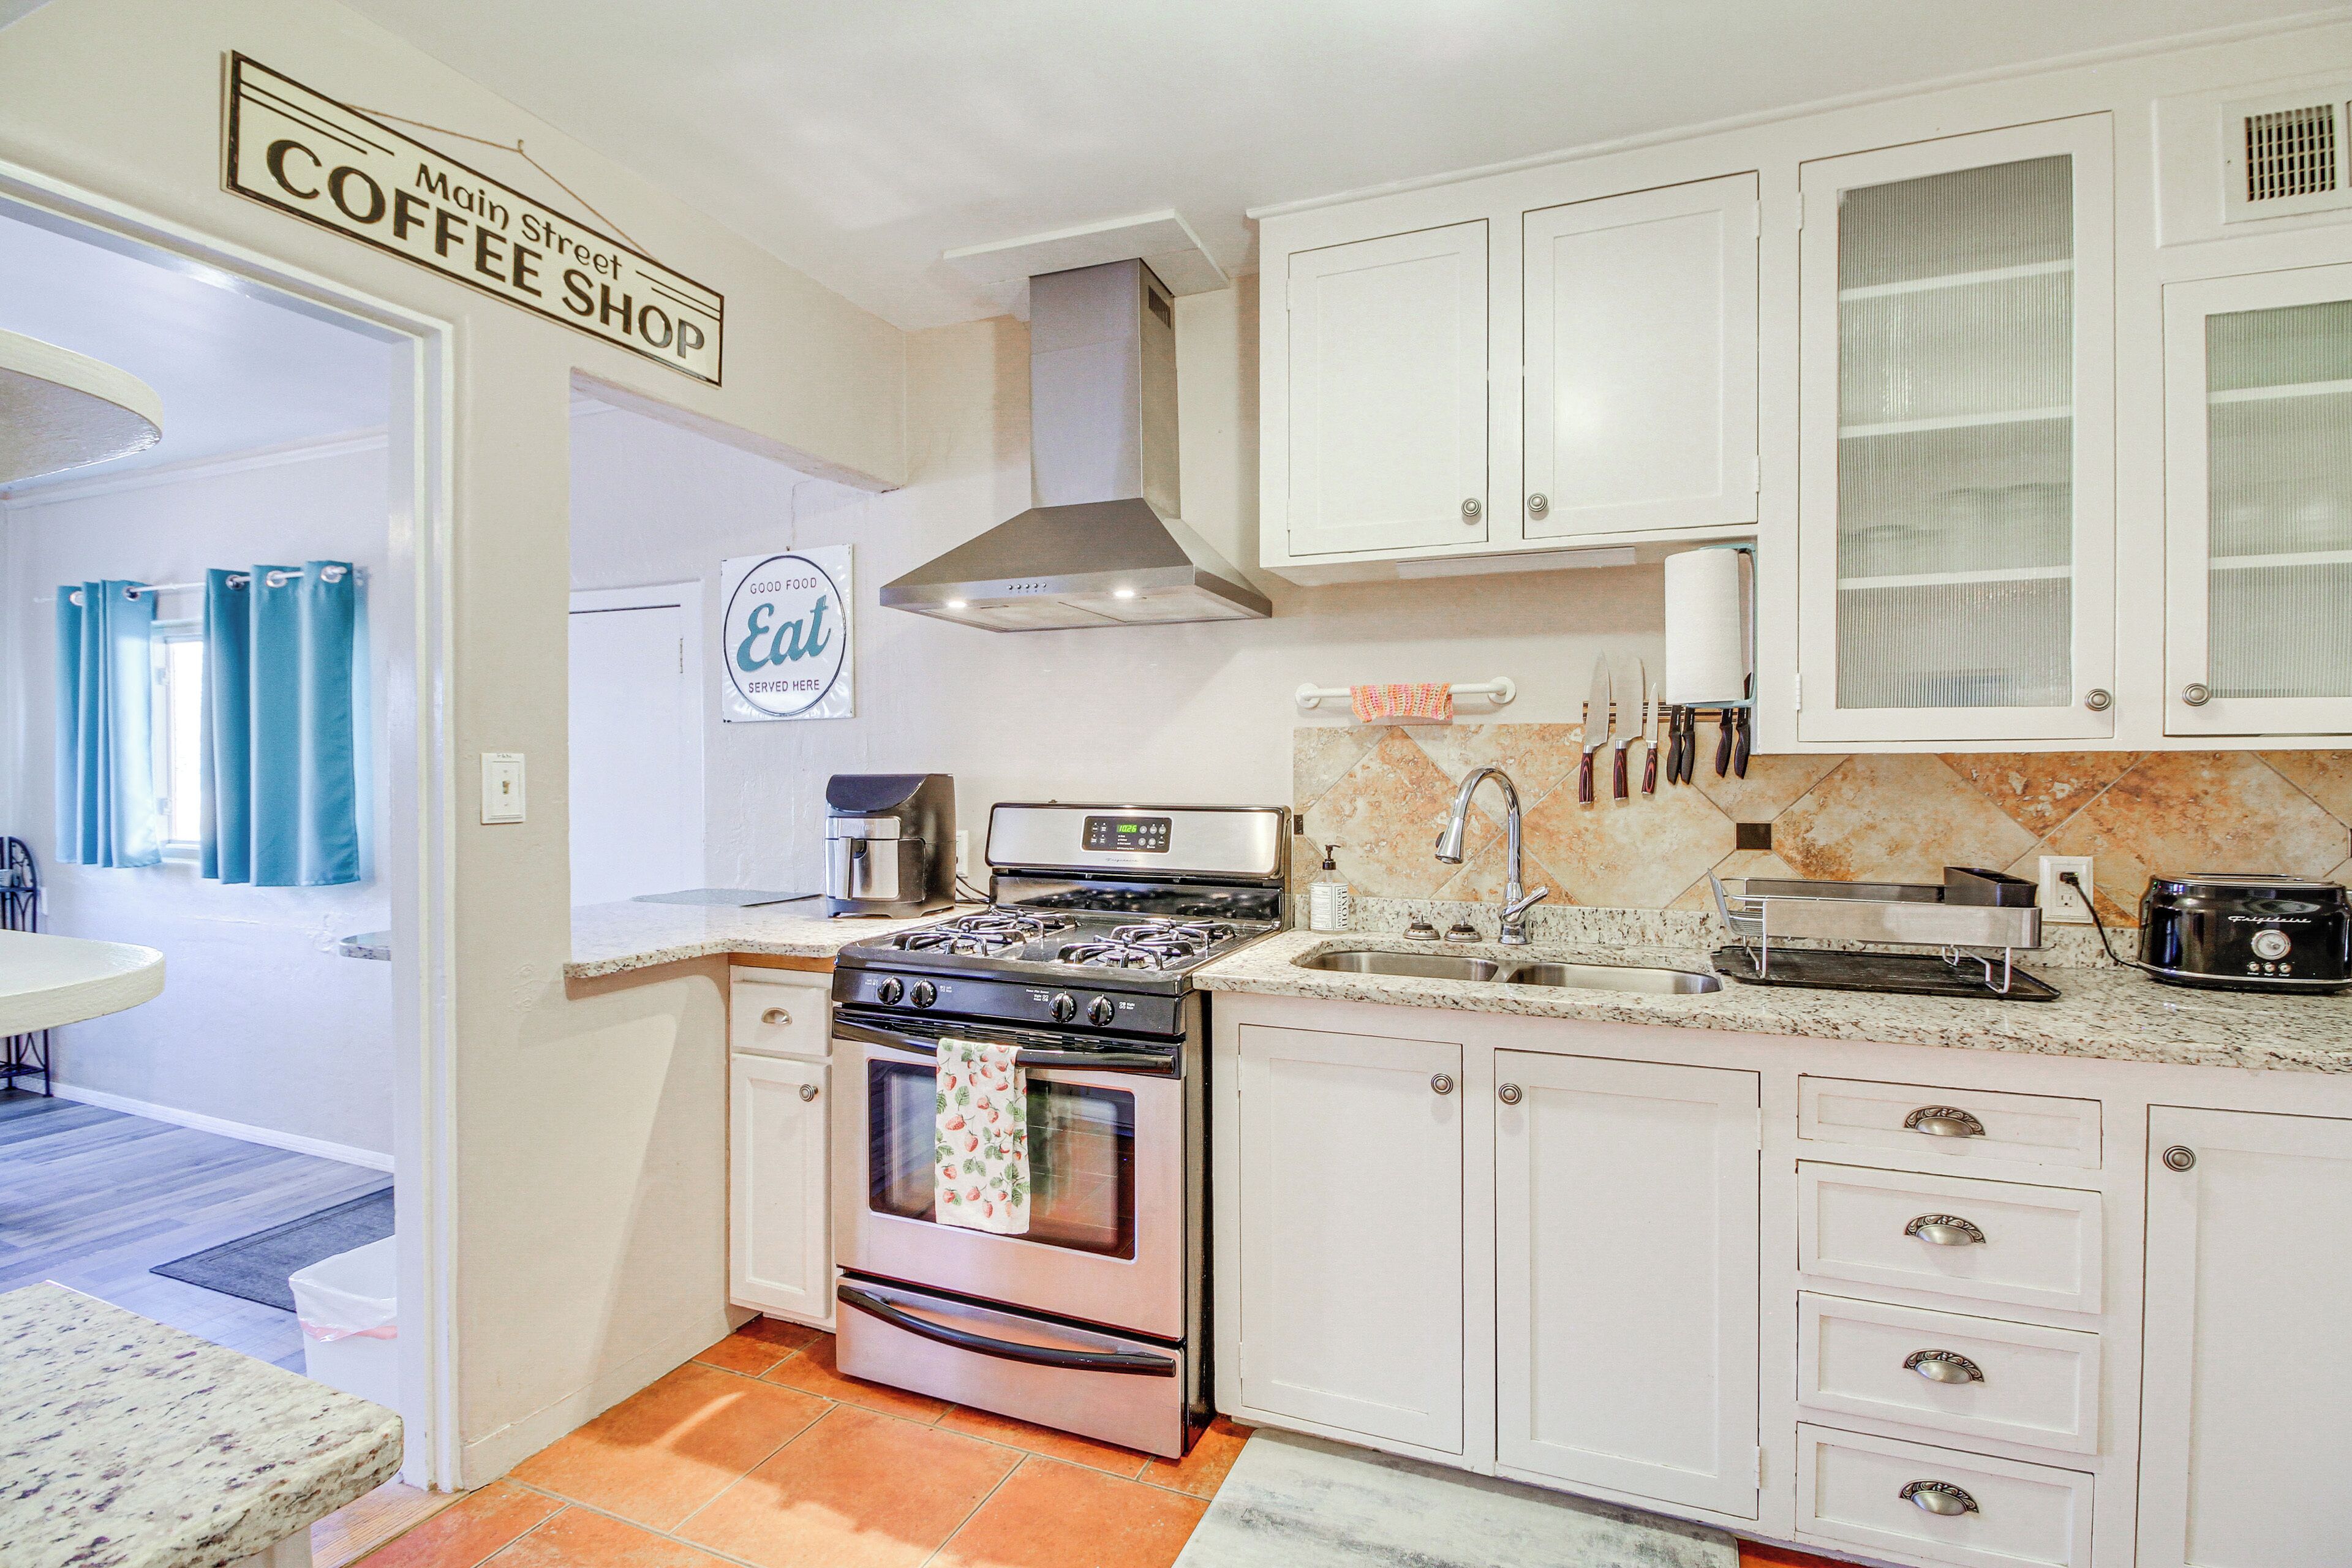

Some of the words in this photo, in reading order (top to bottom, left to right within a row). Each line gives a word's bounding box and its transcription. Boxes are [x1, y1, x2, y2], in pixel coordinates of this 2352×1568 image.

[416, 163, 510, 228] Main
[522, 213, 623, 282] Street
[266, 139, 543, 298] COFFEE
[562, 268, 706, 360] SHOP
[750, 581, 781, 594] GOOD
[786, 578, 816, 590] FOOD
[737, 595, 831, 672] Eat
[748, 680, 788, 693] SERVED
[793, 679, 820, 692] HERE
[2228, 915, 2312, 924] Frigidaire
